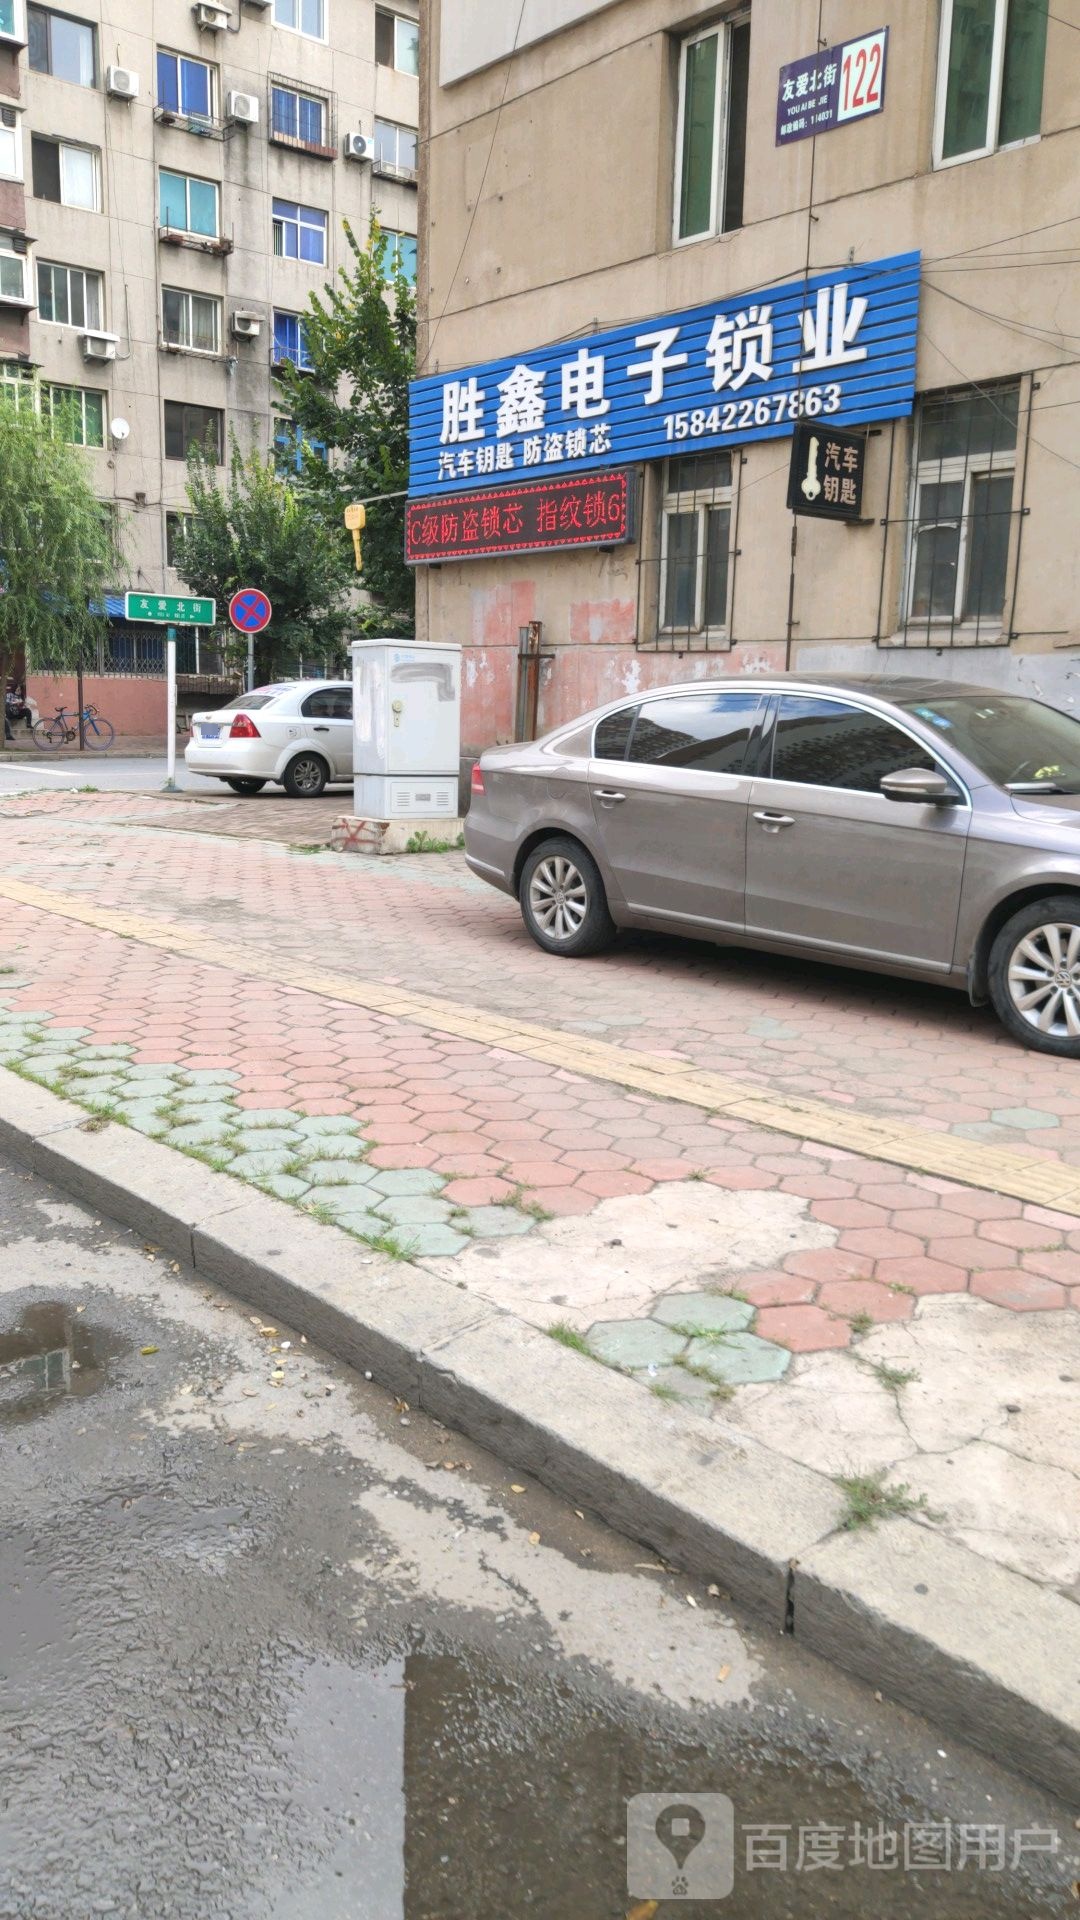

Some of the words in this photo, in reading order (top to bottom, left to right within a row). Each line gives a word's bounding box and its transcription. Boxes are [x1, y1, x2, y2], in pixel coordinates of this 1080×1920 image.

[782, 63, 837, 102] 友爱北街
[843, 43, 881, 111] 122
[787, 104, 800, 116] YOU
[801, 102, 808, 111] AI
[818, 95, 828, 106] JIE
[439, 283, 869, 444] 胜鑫电子锁业
[663, 384, 842, 440] 15842267863
[438, 442, 515, 481] 汽车钥匙
[523, 423, 612, 466] 防盗锁芯
[824, 441, 858, 473] 汽车
[823, 475, 857, 505] 钥匙
[410, 503, 524, 546] C级防盗锁芯
[537, 491, 621, 533] 指纹锁6
[140, 598, 201, 613] 友爱北街
